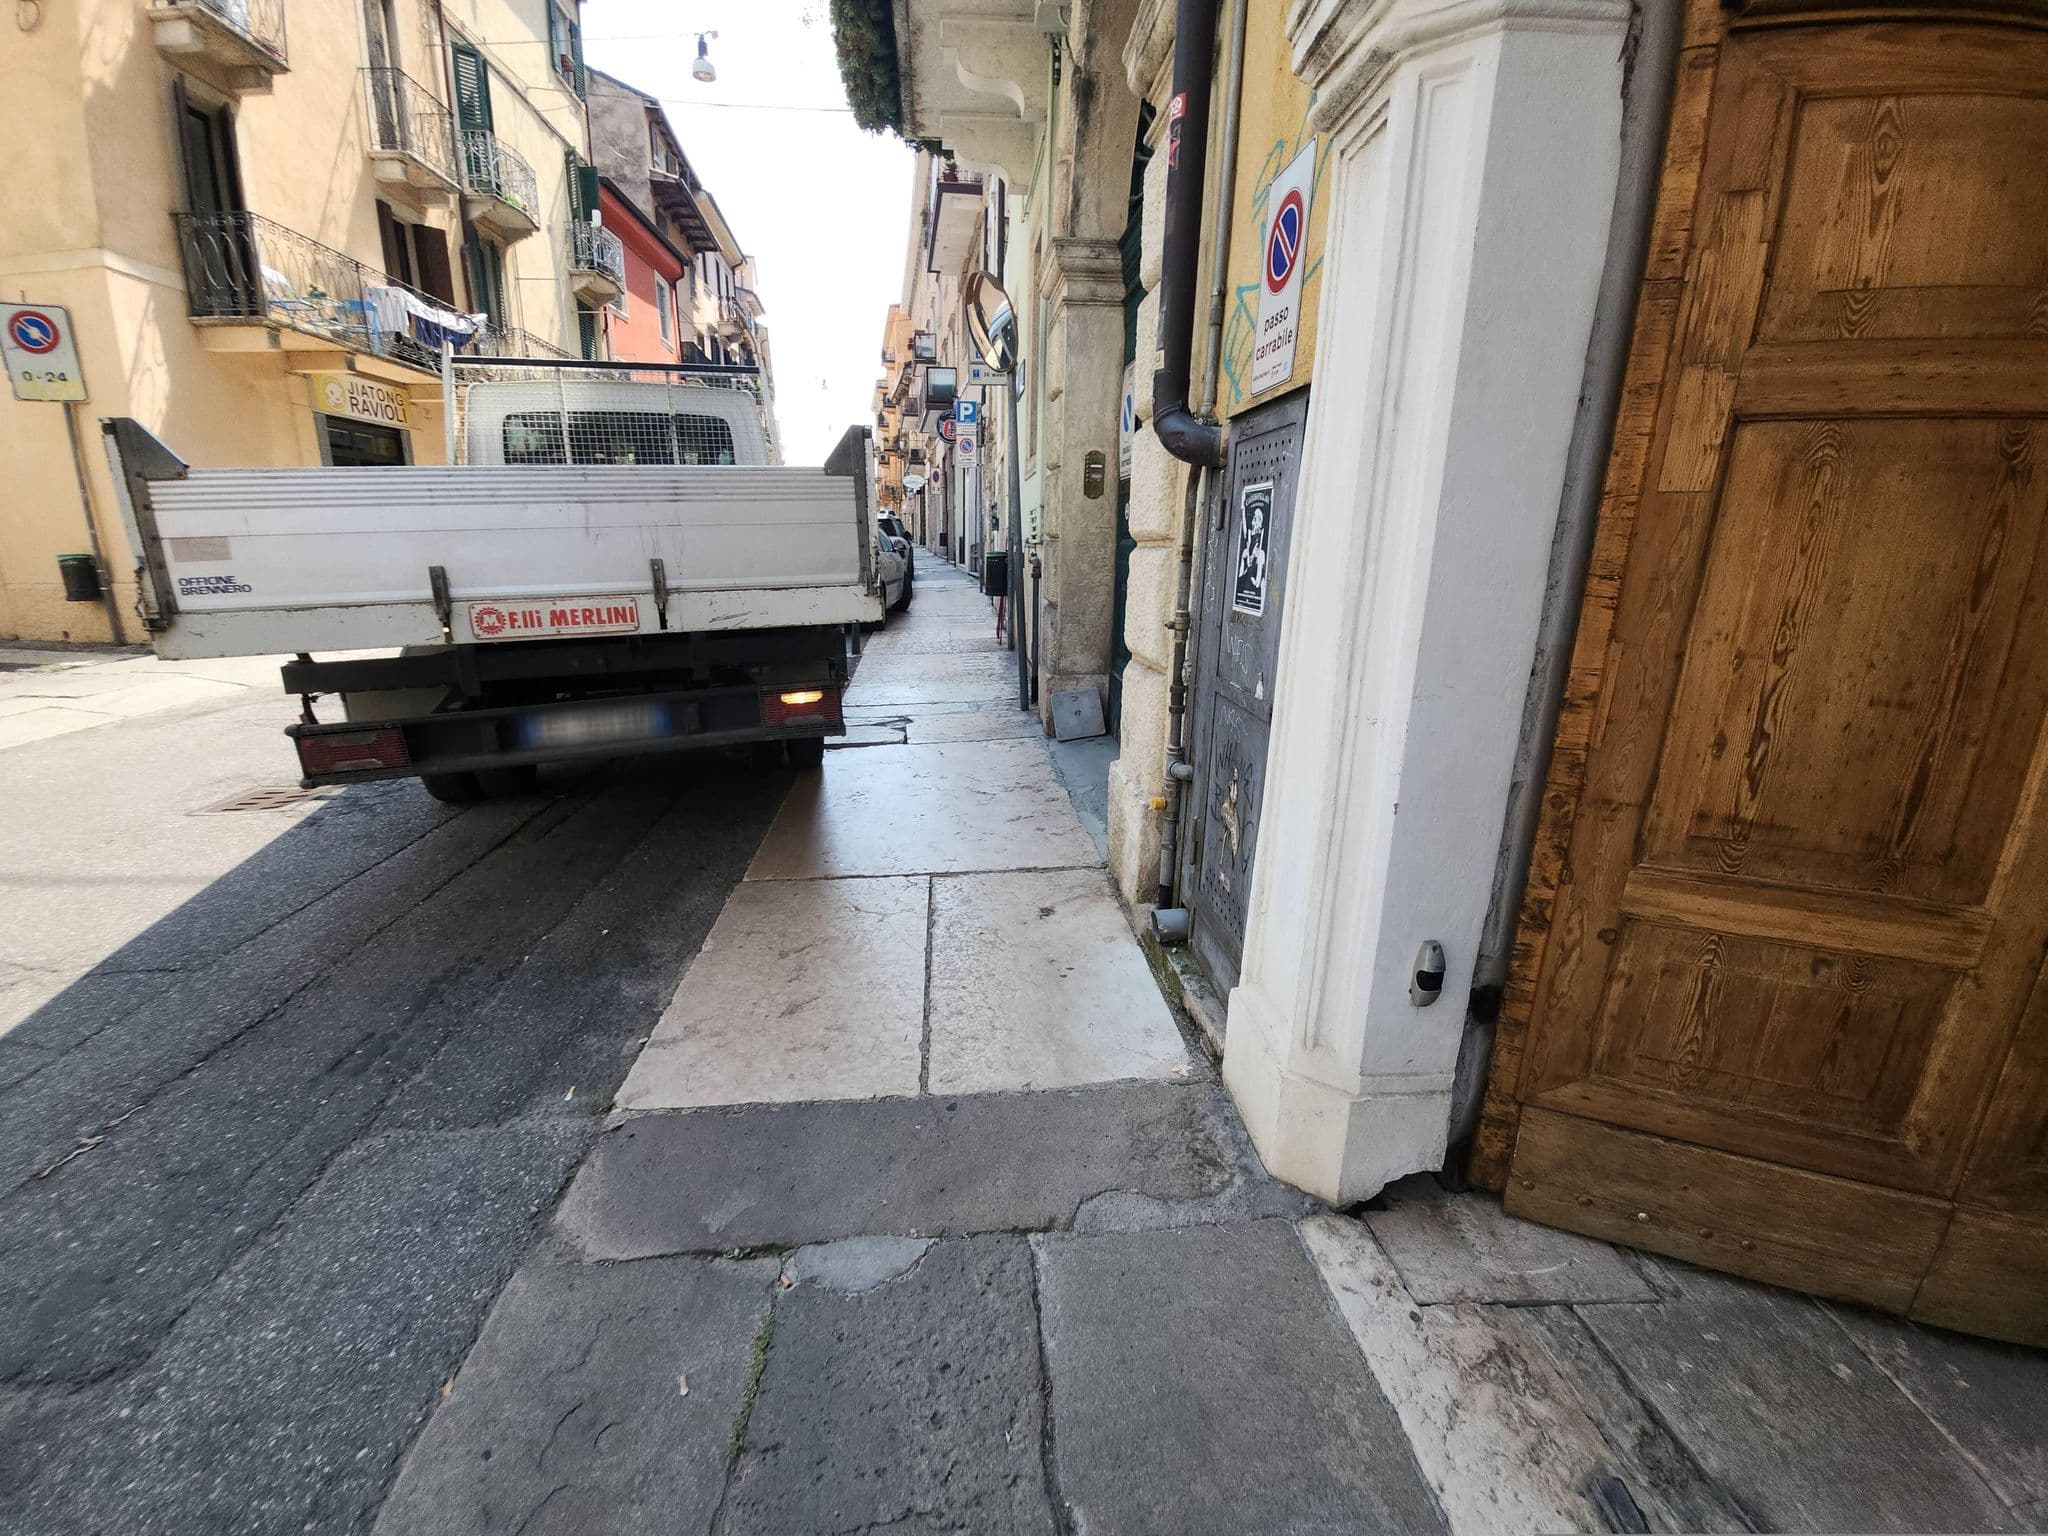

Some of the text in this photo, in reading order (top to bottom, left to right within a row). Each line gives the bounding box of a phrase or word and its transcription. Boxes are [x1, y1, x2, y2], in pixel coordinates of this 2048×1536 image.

[1264, 306, 1289, 336] passo
[1255, 327, 1293, 361] carrabile
[348, 381, 405, 407] JIATONG
[349, 395, 408, 424] RAVIOLI
[959, 402, 974, 422] P
[179, 575, 237, 587] OFFICINE
[180, 584, 252, 596] BRENNERO
[508, 609, 543, 629] F.lli
[550, 606, 635, 627] MERLINI
